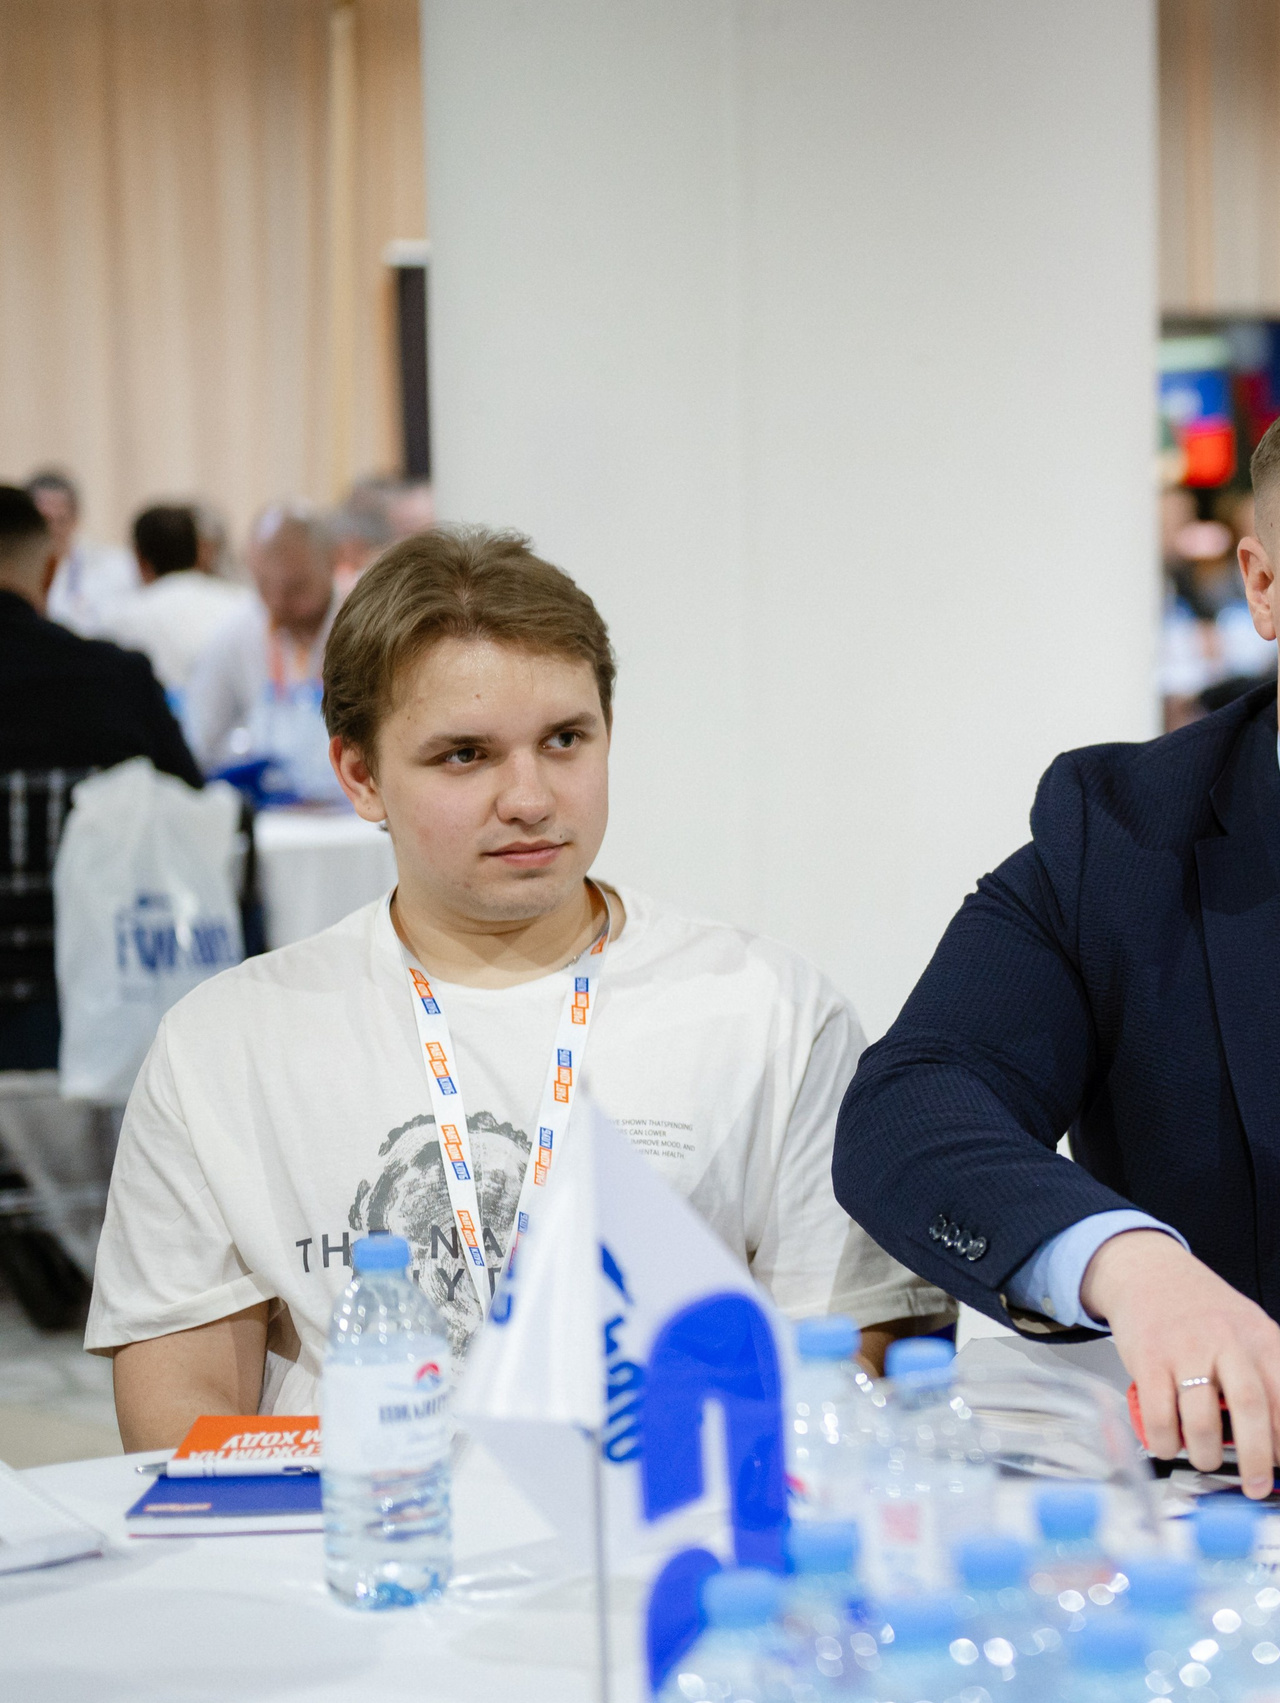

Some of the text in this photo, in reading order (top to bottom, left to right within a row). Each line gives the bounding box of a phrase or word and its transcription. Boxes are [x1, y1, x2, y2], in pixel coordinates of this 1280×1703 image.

[444, 1126, 460, 1143] PART
[541, 1128, 552, 1148] КЛУБ
[645, 1129, 667, 1137] LOWER
[683, 1143, 695, 1151] AND
[536, 1164, 547, 1186] PART
[459, 1212, 473, 1229] PART
[471, 1247, 484, 1266] КЛУБ
[221, 1430, 300, 1450] ХОДУ
